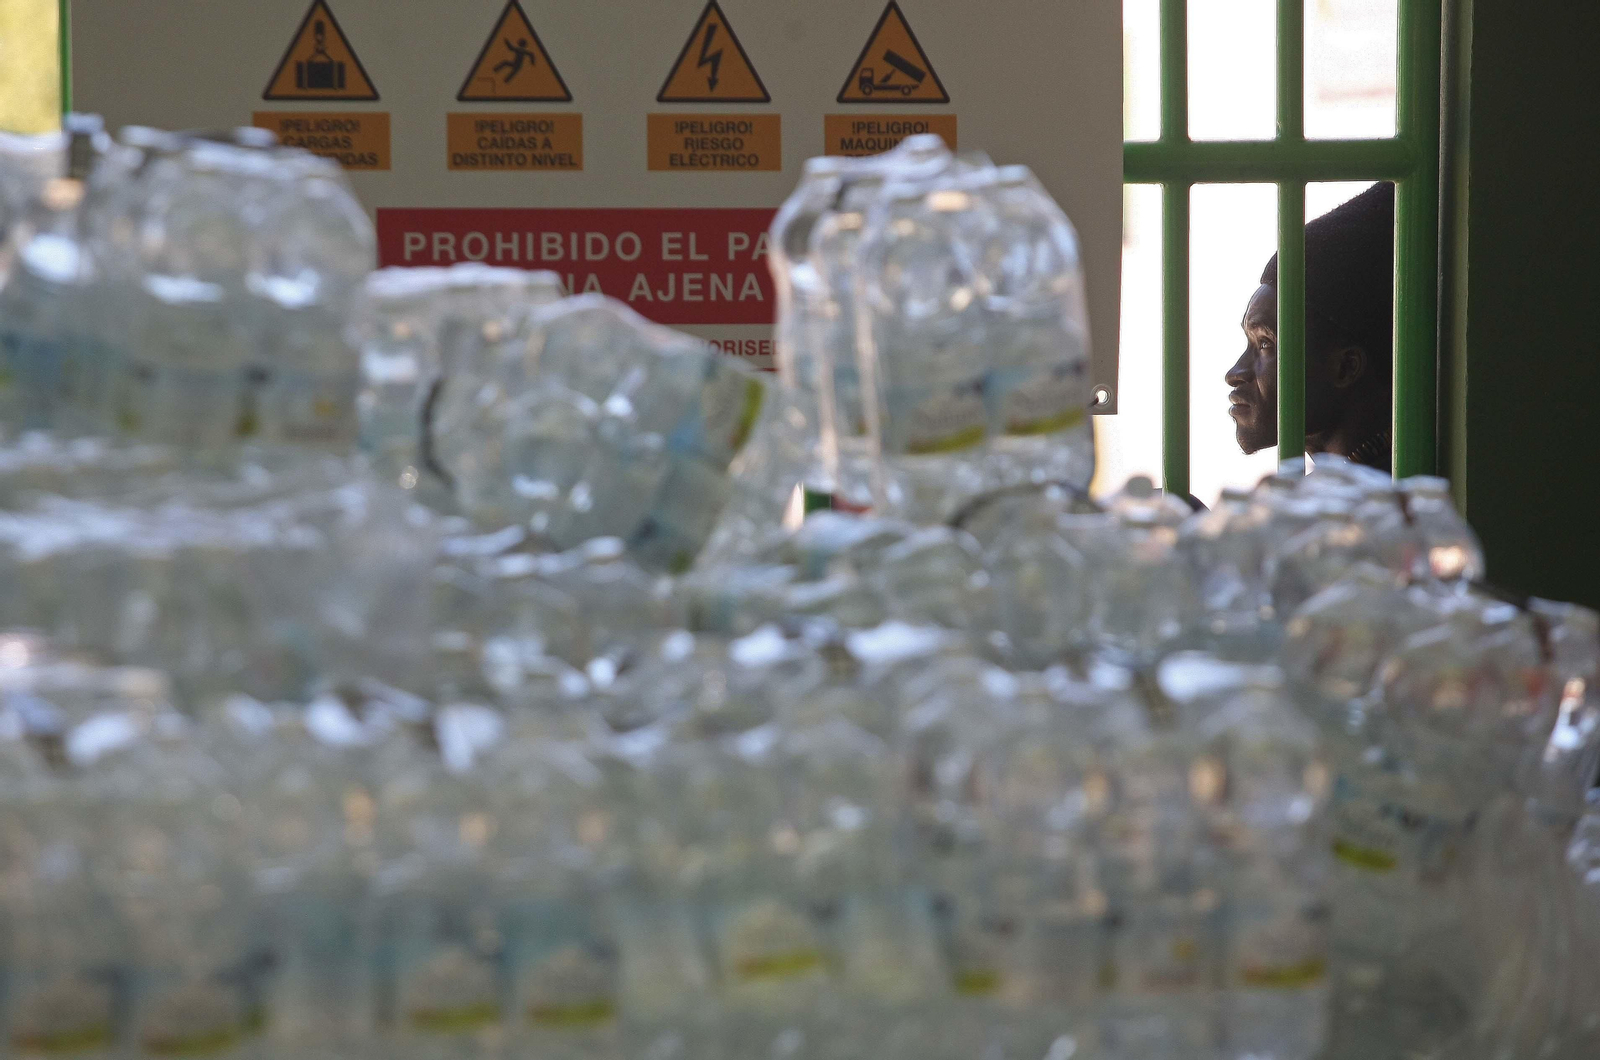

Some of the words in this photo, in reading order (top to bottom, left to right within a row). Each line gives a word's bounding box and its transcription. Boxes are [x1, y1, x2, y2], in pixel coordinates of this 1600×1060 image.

[282, 134, 354, 149] CARGAS
[541, 136, 553, 150] A
[684, 137, 744, 151] RIESGO
[452, 152, 527, 167] DISTINTO
[531, 152, 578, 167] NIVEL
[669, 150, 760, 167] ELÉCTRICO
[403, 231, 643, 262] PROHIBIDO
[661, 231, 709, 261] EL
[728, 231, 771, 261] PA
[557, 272, 605, 297] NA
[628, 272, 765, 303] AJENA
